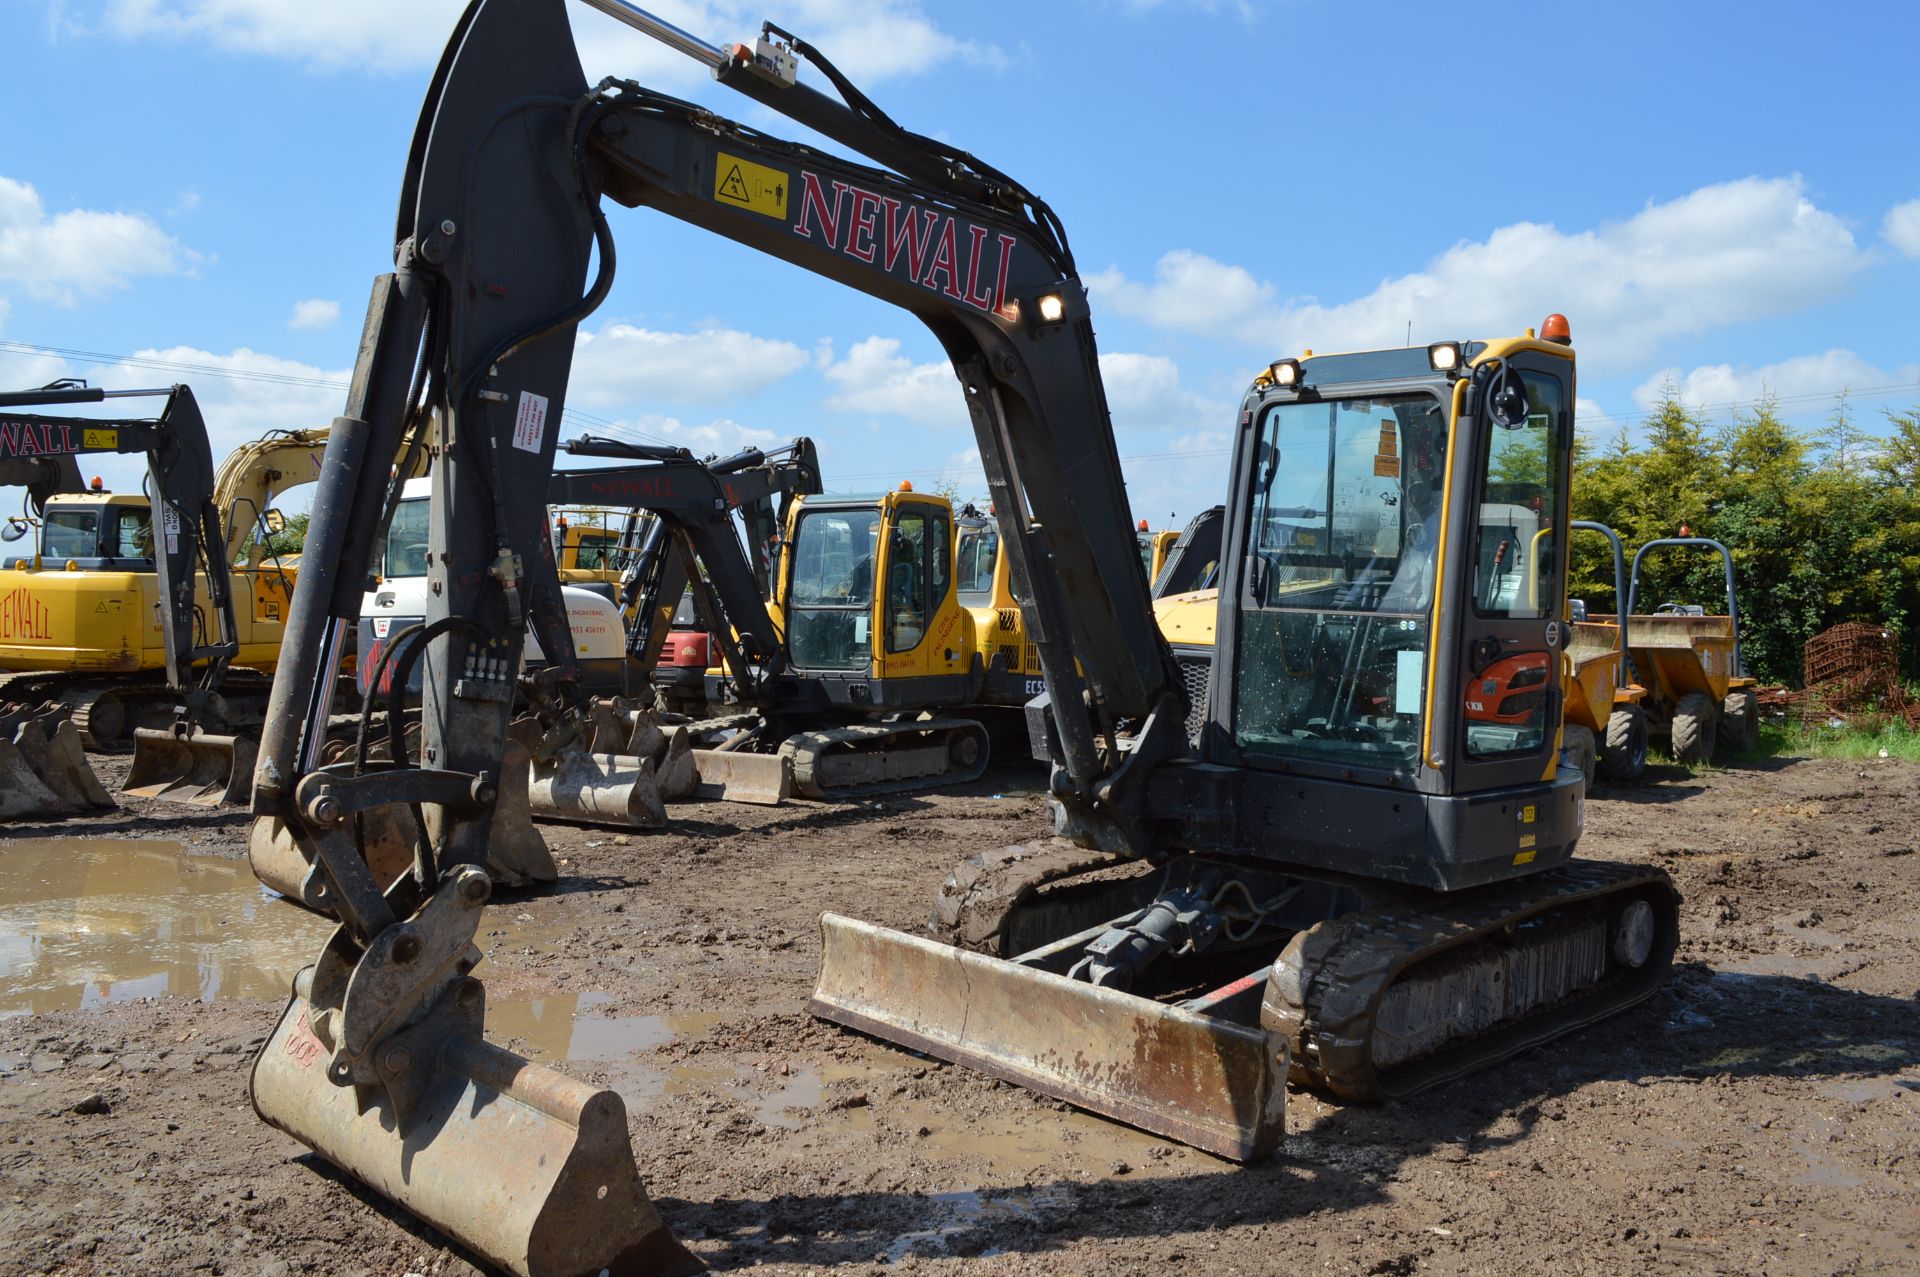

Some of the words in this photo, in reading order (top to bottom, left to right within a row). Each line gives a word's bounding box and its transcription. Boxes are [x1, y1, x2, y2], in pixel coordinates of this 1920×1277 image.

[794, 170, 1020, 323] NEWALL
[591, 477, 677, 498] NEWALL
[0, 585, 53, 640] EWALL
